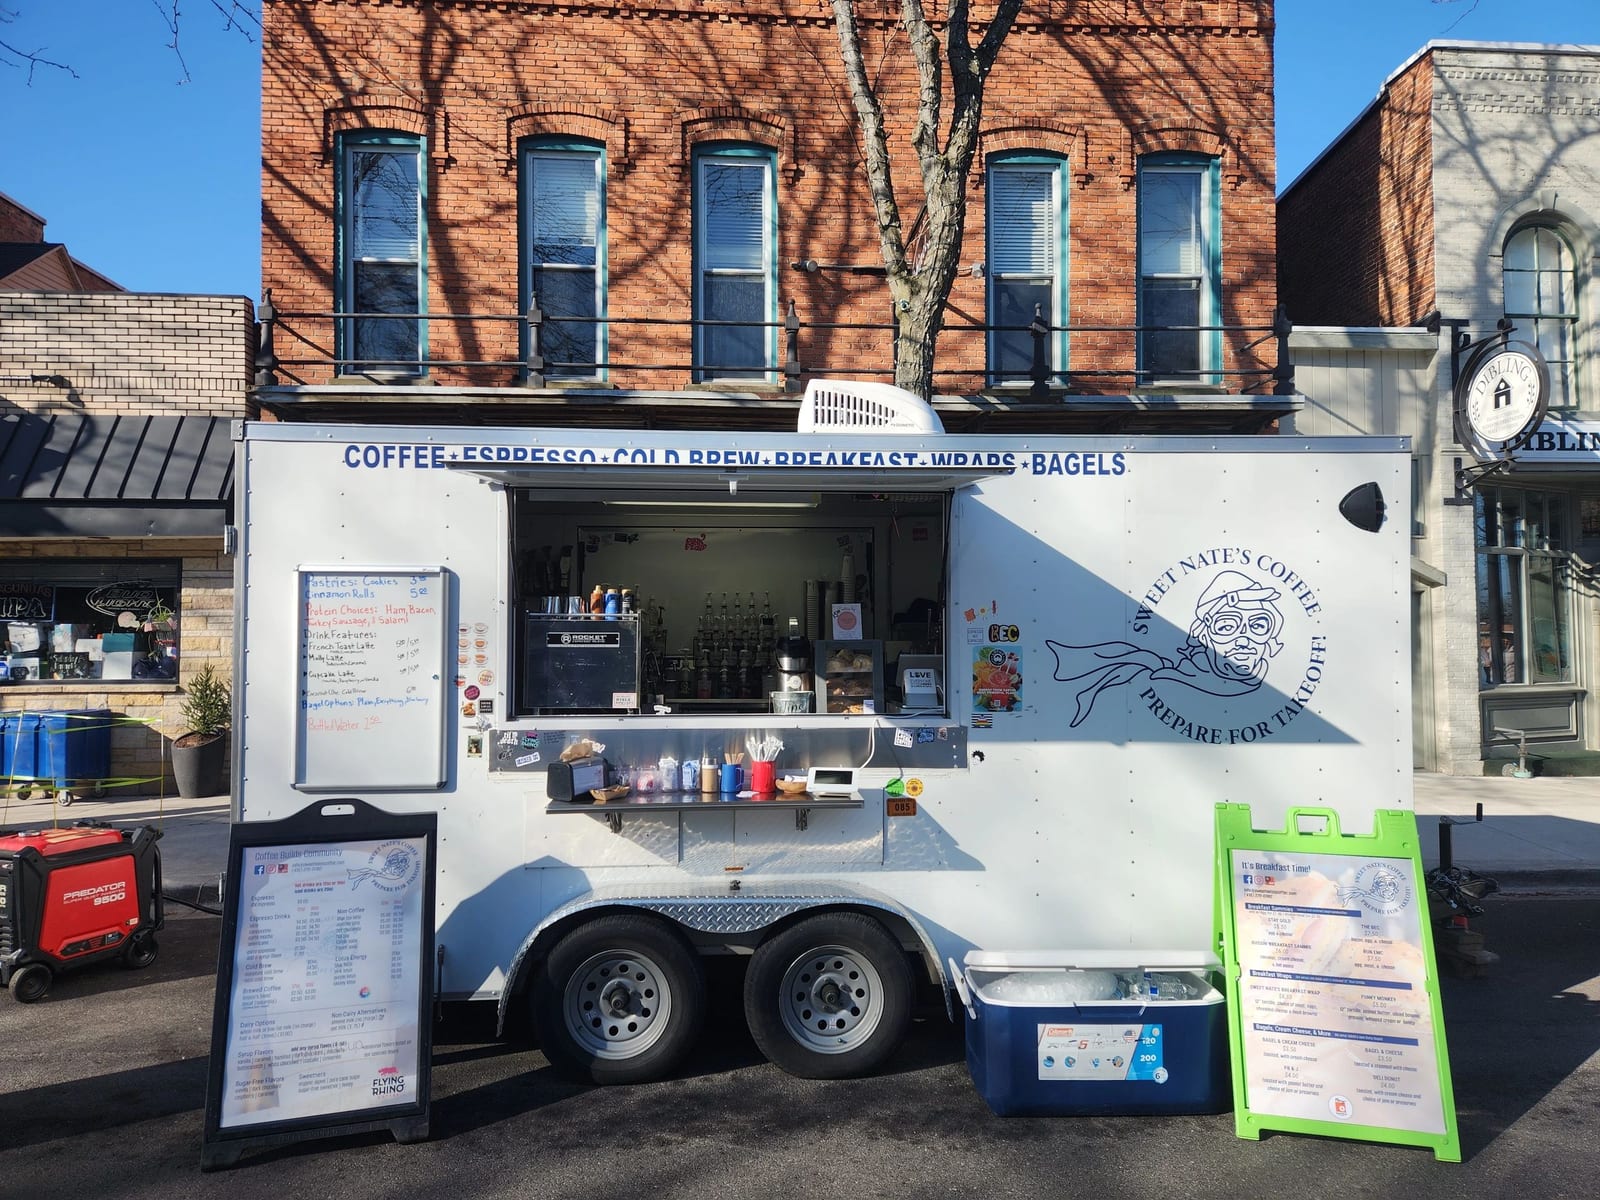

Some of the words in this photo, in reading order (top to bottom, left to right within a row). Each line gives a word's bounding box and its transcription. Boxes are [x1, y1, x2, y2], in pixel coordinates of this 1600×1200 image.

[1476, 358, 1531, 395] DIBLING
[344, 444, 446, 468] COFFEE
[1032, 452, 1126, 476] BAGELS
[304, 590, 351, 599] Cinnamon
[1133, 567, 1180, 635] SWEET
[1179, 547, 1251, 576] NATE'S
[1256, 554, 1322, 618] COFFEE
[304, 630, 330, 639] Drink
[331, 630, 377, 639] Features:
[308, 642, 334, 650] French
[356, 642, 376, 650] Latte
[1139, 686, 1222, 744] PREPARE
[1229, 720, 1274, 744] FOR
[1271, 635, 1326, 728] TAKEOFF!
[895, 802, 910, 812] 085
[255, 852, 278, 861] Coffee
[303, 850, 342, 858] Community
[1242, 862, 1254, 870] It's
[1255, 862, 1290, 872] Breakfast
[1292, 864, 1311, 873] Time!
[64, 881, 126, 900] PREDATOR
[94, 892, 126, 906] 9500
[1252, 970, 1276, 978] Breakfast
[357, 1007, 387, 1016] Alternatives
[240, 1022, 254, 1030] Dairy
[255, 1020, 276, 1028] Options
[1292, 1026, 1312, 1034] Cheese,
[1140, 1054, 1156, 1062] 200
[236, 1080, 250, 1088] Sugar
[251, 1078, 264, 1086] Free
[264, 1076, 284, 1084] Flavors
[372, 1076, 404, 1087] FLYING
[372, 1084, 406, 1096] RHINO
